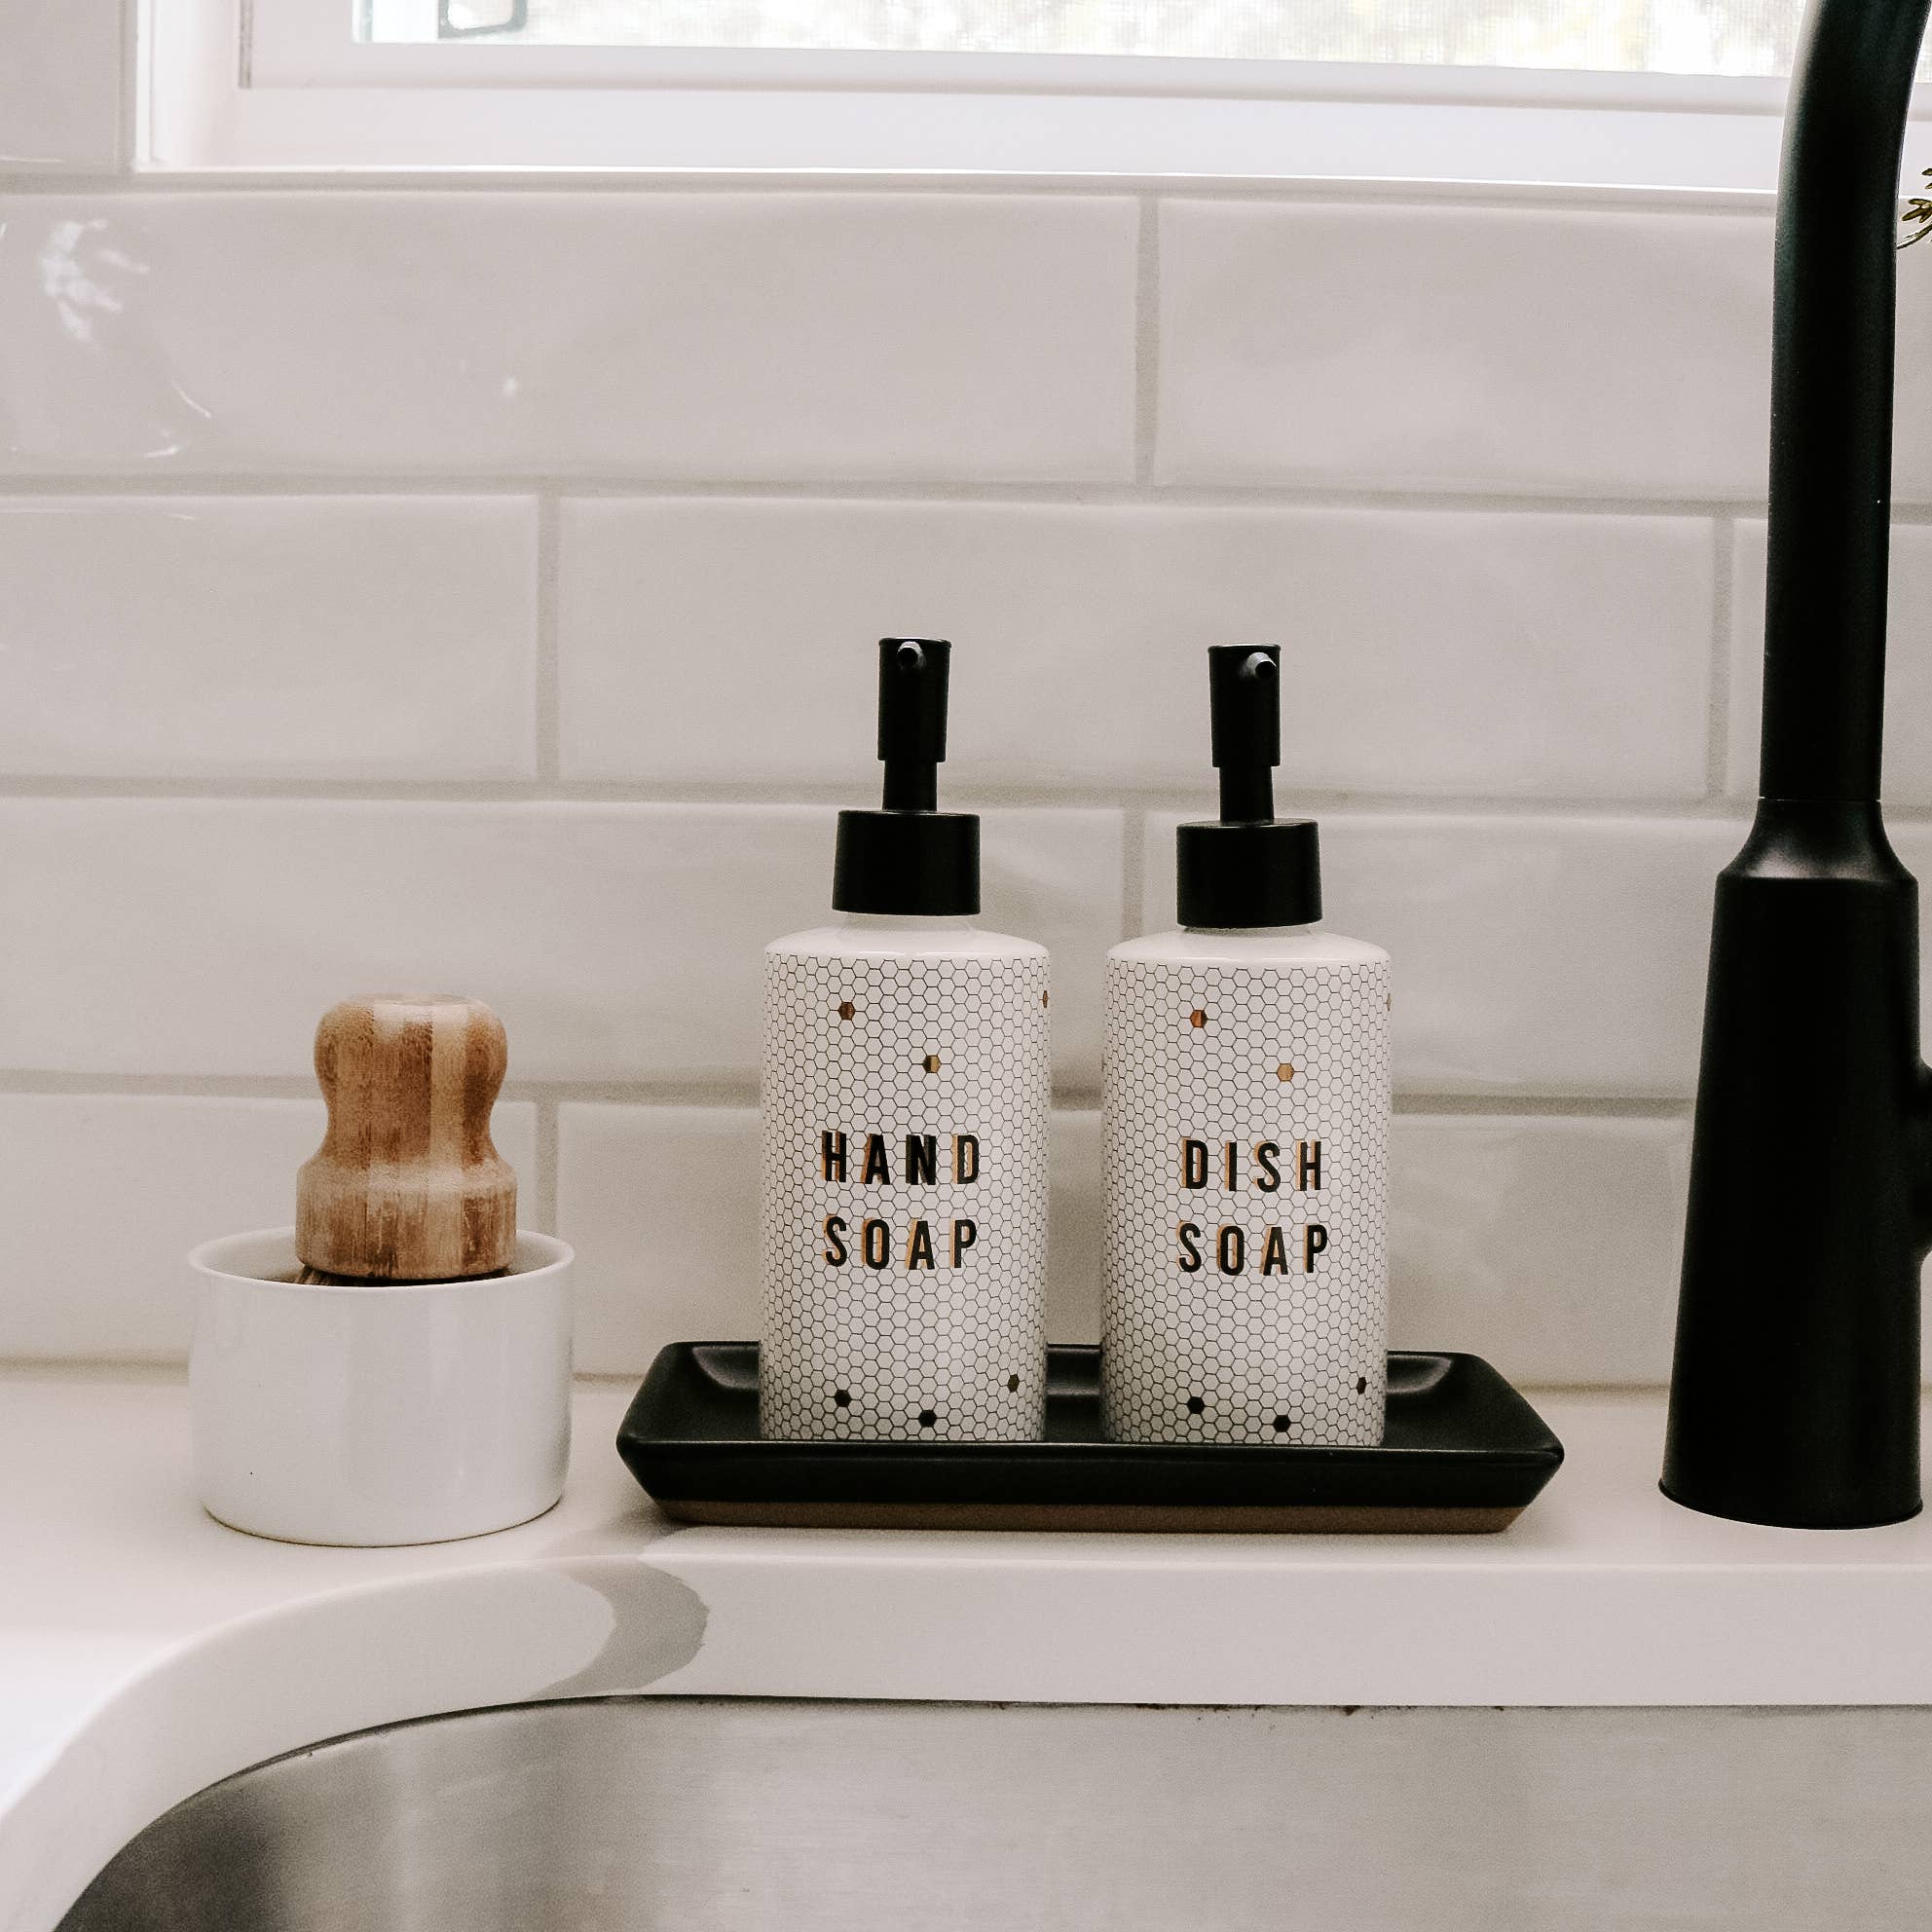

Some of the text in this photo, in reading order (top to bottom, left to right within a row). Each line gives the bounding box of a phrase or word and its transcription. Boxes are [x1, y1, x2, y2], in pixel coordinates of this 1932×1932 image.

[822, 1131, 980, 1185] HAND
[1181, 1137, 1321, 1193] DISH
[823, 1215, 977, 1270] SOAP
[1176, 1221, 1328, 1276] SOAP
